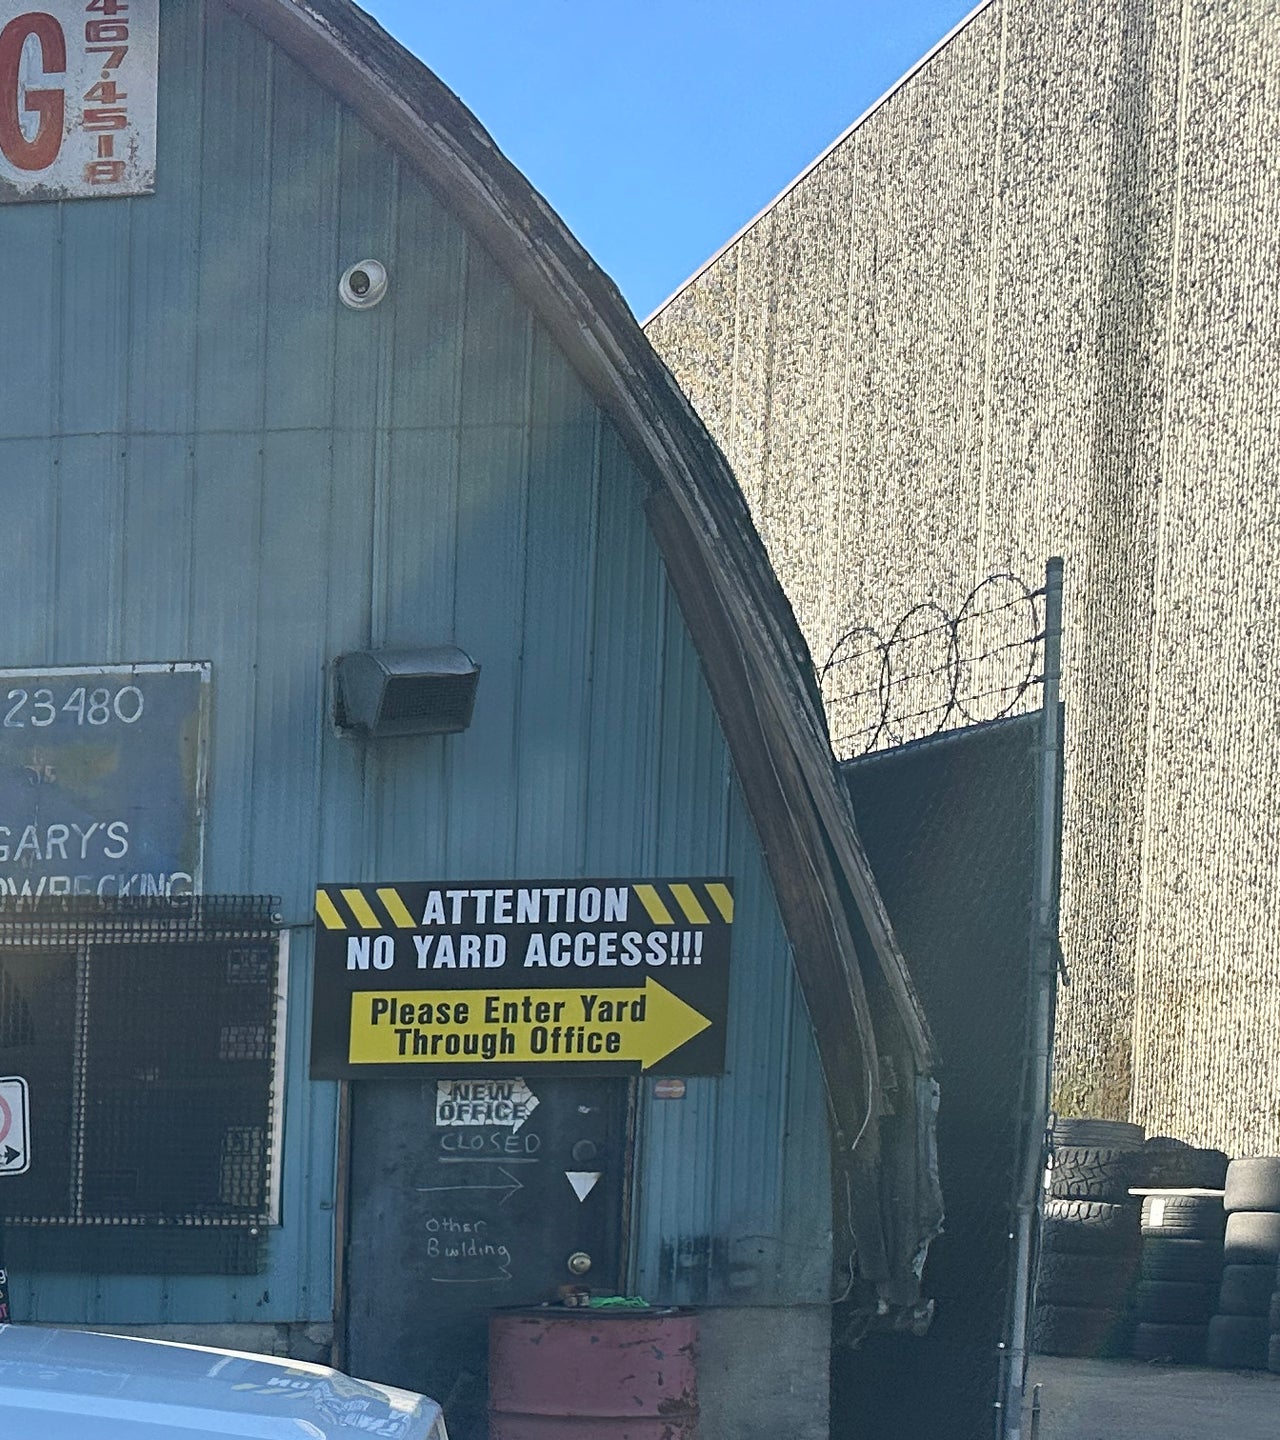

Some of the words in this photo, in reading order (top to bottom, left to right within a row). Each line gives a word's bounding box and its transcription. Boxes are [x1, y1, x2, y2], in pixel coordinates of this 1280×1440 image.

[3, 686, 144, 728] 23480
[421, 886, 628, 925] ATTENTION
[347, 936, 395, 971] NO
[413, 934, 506, 969] YARD
[524, 931, 704, 967] ACCESS!!!
[371, 998, 469, 1025] Please
[485, 996, 566, 1024] Enter
[582, 995, 647, 1022] Yard
[394, 1028, 515, 1060] Through
[530, 1026, 621, 1054] Office
[451, 1083, 514, 1101] NEW
[440, 1101, 527, 1121] OFFICE
[441, 1132, 540, 1153] CLOSED
[426, 1218, 487, 1233] Other
